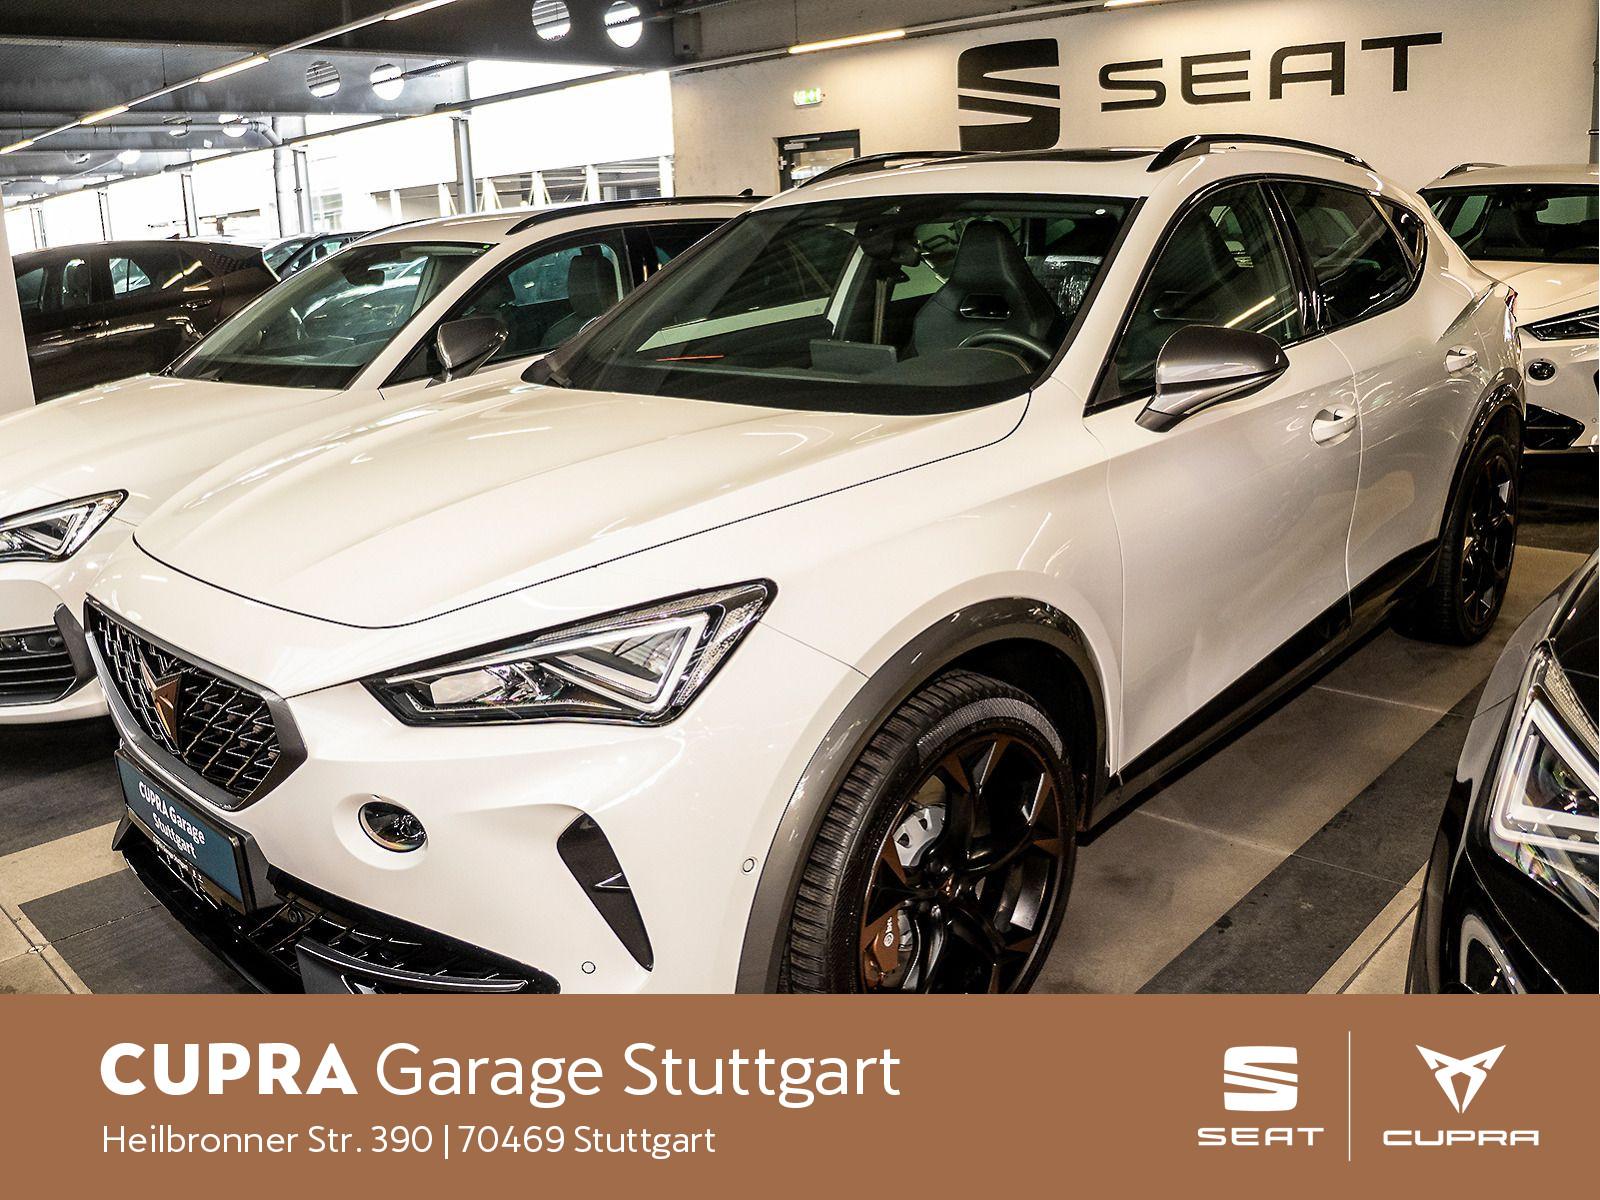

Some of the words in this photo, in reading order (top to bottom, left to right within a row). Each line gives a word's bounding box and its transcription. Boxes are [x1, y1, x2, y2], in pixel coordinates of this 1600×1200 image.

[1098, 32, 1443, 112] SEAT
[138, 780, 170, 819] CUPRA
[169, 806, 206, 845] Garage
[152, 812, 198, 859] Stuttgart
